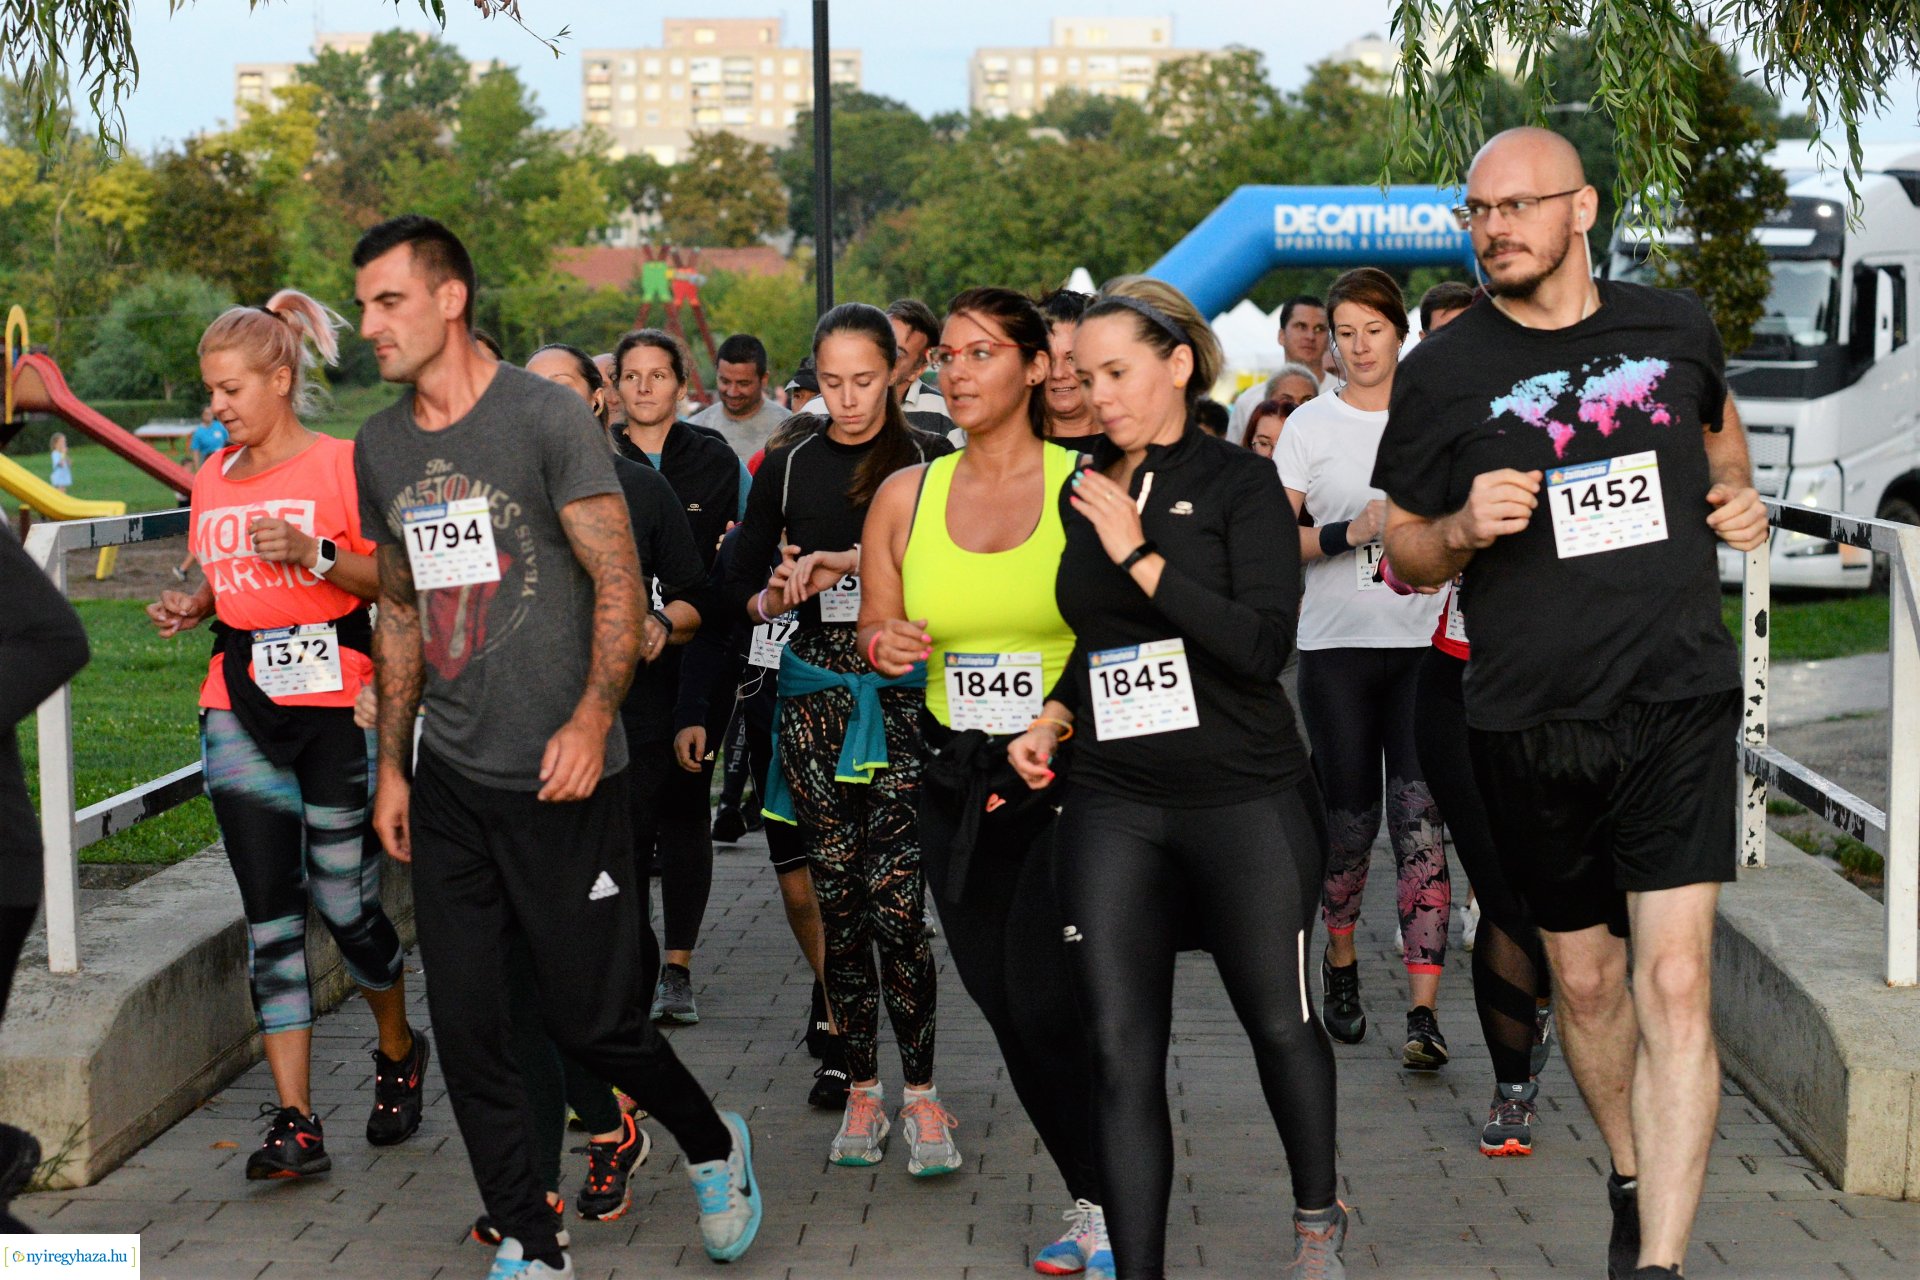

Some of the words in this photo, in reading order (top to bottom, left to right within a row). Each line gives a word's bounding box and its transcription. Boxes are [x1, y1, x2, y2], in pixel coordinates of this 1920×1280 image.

[1274, 204, 1469, 235] DECATHLON
[425, 458, 453, 475] The
[1560, 475, 1651, 516] 1452
[412, 519, 483, 552] 1794
[214, 559, 319, 596] ARDIO
[262, 639, 329, 667] 1372
[953, 671, 1033, 697] 1846
[1099, 661, 1178, 698] 1845
[824, 1069, 847, 1080] UMA
